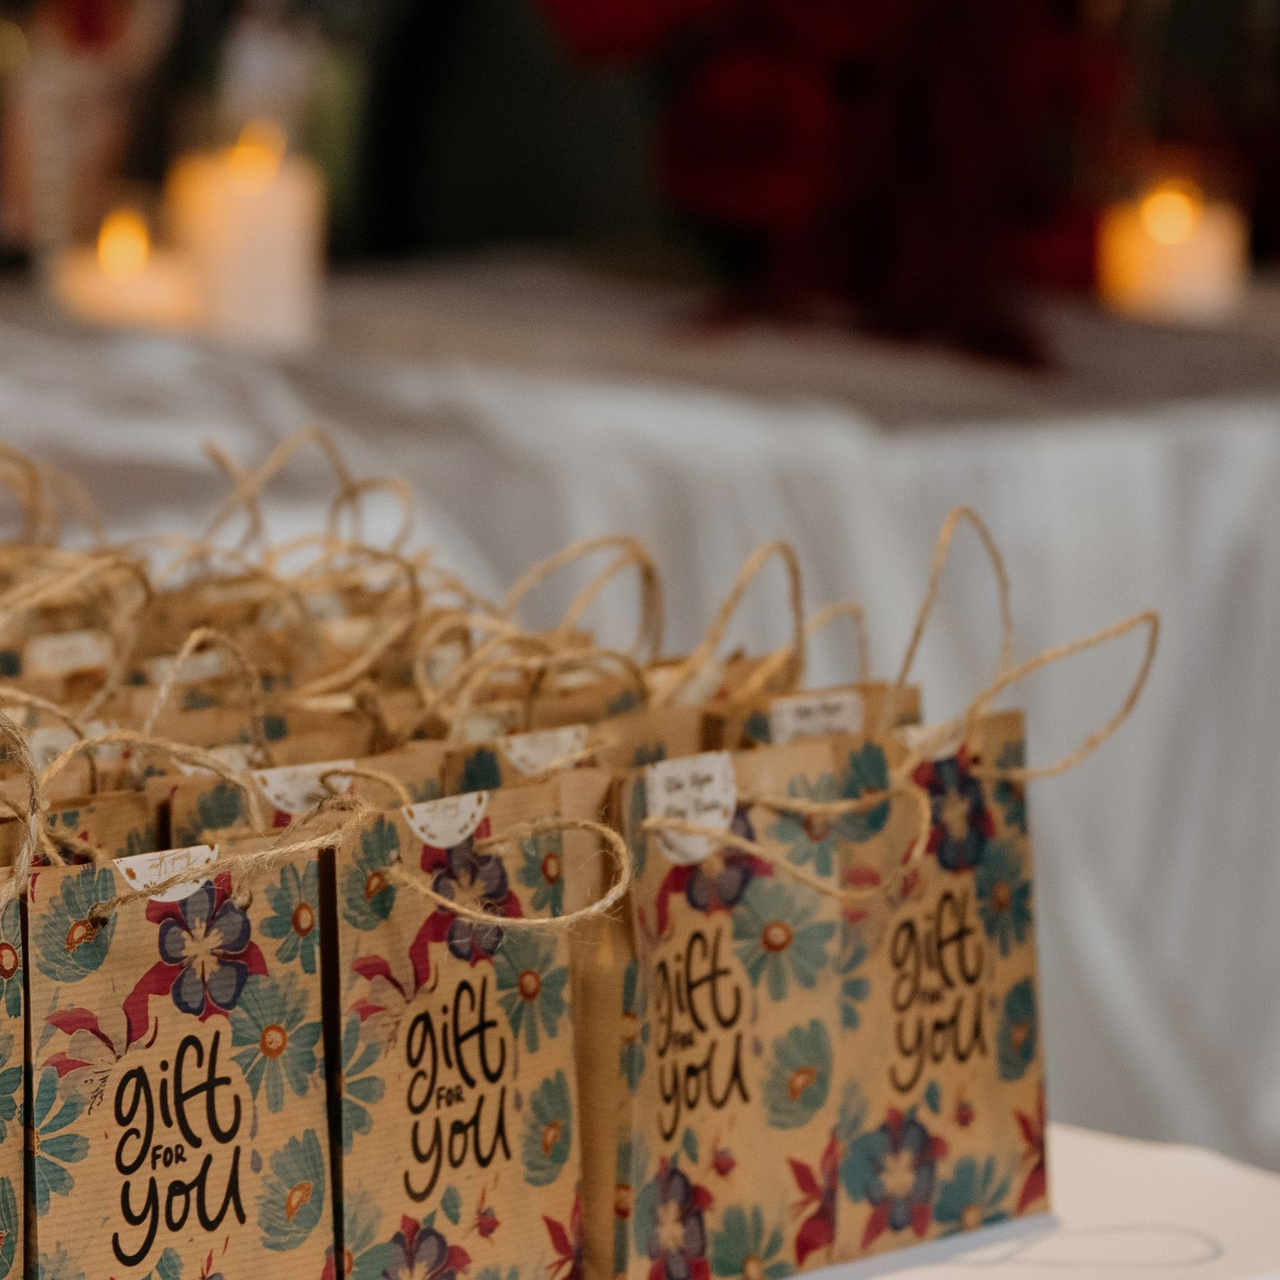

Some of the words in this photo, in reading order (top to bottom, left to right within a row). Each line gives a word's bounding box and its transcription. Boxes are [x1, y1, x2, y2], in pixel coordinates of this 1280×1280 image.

[888, 888, 984, 1014] gift
[406, 976, 506, 1115] gift
[436, 1085, 465, 1108] FOR
[658, 1032, 750, 1141] you
[888, 990, 987, 1093] you
[113, 1030, 241, 1176] gift
[151, 1144, 188, 1170] FOR
[404, 1086, 511, 1202] you
[112, 1145, 247, 1267] you
